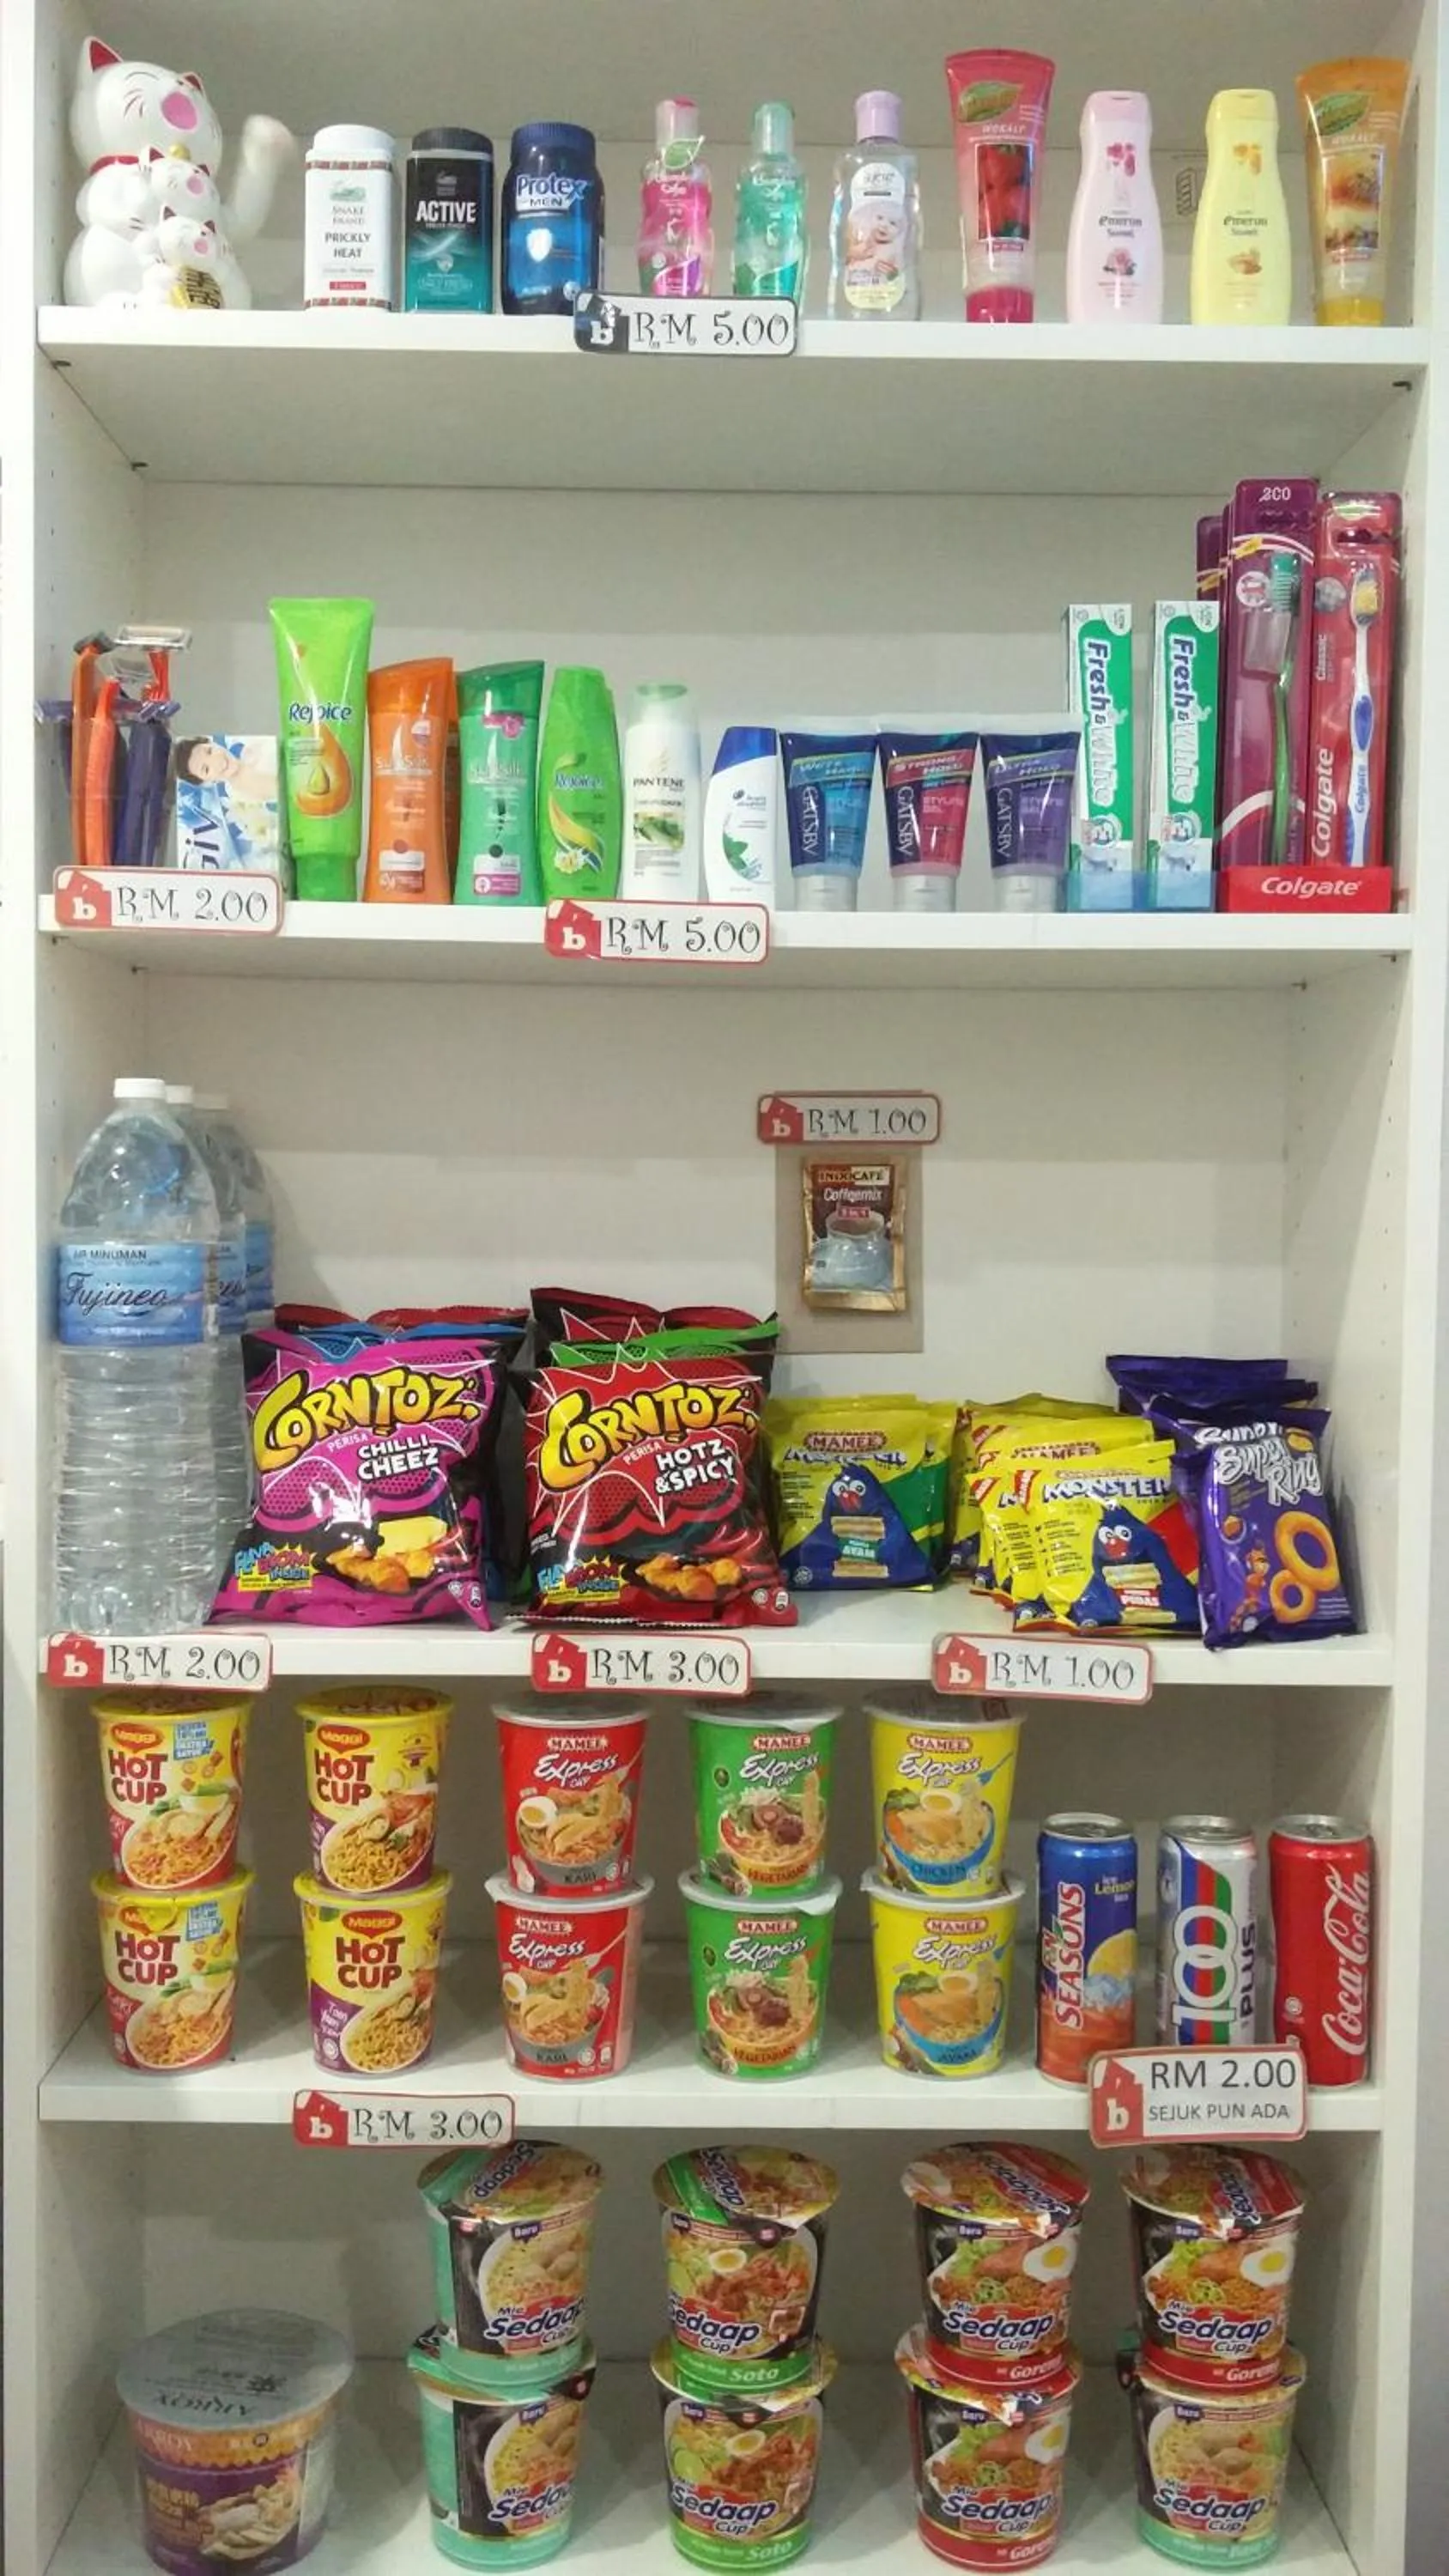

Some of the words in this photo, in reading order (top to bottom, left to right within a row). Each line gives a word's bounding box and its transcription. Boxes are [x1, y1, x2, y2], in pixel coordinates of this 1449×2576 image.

[518, 175, 588, 200] Protex
[530, 198, 562, 207] MEN
[415, 200, 477, 224] ACTIVE
[324, 233, 371, 243] PRICKLY
[334, 248, 362, 258] HEAT
[635, 313, 697, 349] RM
[713, 310, 789, 346] 5.00
[1315, 634, 1328, 681] Classic
[1088, 641, 1111, 714] Fresh
[1173, 638, 1196, 710] Fresh
[288, 702, 352, 723] Rejoice
[634, 777, 684, 788] PANTENE
[1355, 764, 1368, 814] Colgate
[1312, 748, 1337, 857] Colgate
[802, 786, 820, 856] GATSBY
[897, 786, 914, 857] GATSBY
[997, 787, 1012, 858] GATSBY
[1261, 876, 1360, 899] Colgate
[117, 886, 179, 923] RM
[195, 888, 268, 922] 2.00
[607, 916, 669, 955] RM
[686, 916, 761, 953] 5.00
[809, 1109, 858, 1139] RM
[870, 1108, 927, 1134] 1.00
[823, 1187, 883, 1202] Coffeemix
[90, 1249, 147, 1260] MINUMAN
[64, 1272, 168, 1316] Fujineo
[253, 1366, 481, 1473] CORNTOZ
[328, 1432, 369, 1453] PERISA
[357, 1433, 428, 1460] CHILLI
[540, 1382, 757, 1492] CORNTOZ
[812, 1436, 881, 1448] MAMEE
[357, 1446, 440, 1481] CHEEZ
[623, 1440, 662, 1466] PERISA
[656, 1439, 728, 1471] HOTZ
[1215, 1436, 1290, 1485] Super
[1268, 1453, 1323, 1505] Ring
[842, 1545, 876, 1558] AYAM
[110, 1644, 171, 1681] RM
[185, 1646, 260, 1681] 2.00
[590, 1647, 654, 1685] RM
[669, 1649, 740, 1686] 3.00
[992, 1652, 1052, 1688] RM
[1065, 1656, 1134, 1690] 1.00
[551, 1738, 601, 1750] MAMEE
[758, 1737, 809, 1748] MAMEE
[913, 1738, 966, 1750] MAMEE
[108, 1749, 168, 1779] HOT
[314, 1748, 375, 1781] HOT
[534, 1753, 619, 1787] Express
[739, 1753, 820, 1786] Express
[898, 1751, 983, 1786] Express
[111, 1777, 167, 1805] CUP
[317, 1777, 373, 1806] CUP
[519, 1918, 569, 1931] MAMEE
[741, 1921, 791, 1932] MAMEE
[931, 1921, 982, 1931] MAMEE
[114, 1930, 181, 1961] HOT
[336, 1936, 405, 1964] HOT
[508, 1933, 587, 1967] Express
[724, 1936, 808, 1969] Express
[912, 1935, 997, 1969] Express
[1056, 1883, 1084, 2028] SEASONS
[118, 1959, 178, 1985] CUP
[337, 1965, 403, 1989] CUP
[1172, 1905, 1237, 2025] 100
[1240, 1925, 1255, 2018] PLUS
[1151, 2060, 1206, 2089] RM
[1222, 2059, 1296, 2088] 2.00
[354, 2108, 415, 2143] RM
[429, 2110, 503, 2140] 3.00
[1149, 2105, 1201, 2121] SEJUK
[1207, 2104, 1245, 2119] PUN
[1251, 2103, 1290, 2118] ADA
[945, 2312, 1053, 2339] Sedaap
[1161, 2312, 1272, 2343] Sedaap
[700, 2338, 731, 2353] Cup
[997, 2338, 1030, 2351] Cup
[1214, 2342, 1247, 2353] Cup
[730, 2368, 779, 2382] Soto
[672, 2485, 777, 2525] Sedaap
[943, 2495, 1052, 2520] Sedaap
[1155, 2488, 1266, 2521] Sedaap
[715, 2521, 748, 2535] Cup
[997, 2521, 1029, 2533] Cup
[1208, 2520, 1242, 2532] Cup
[747, 2541, 792, 2560] Soto
